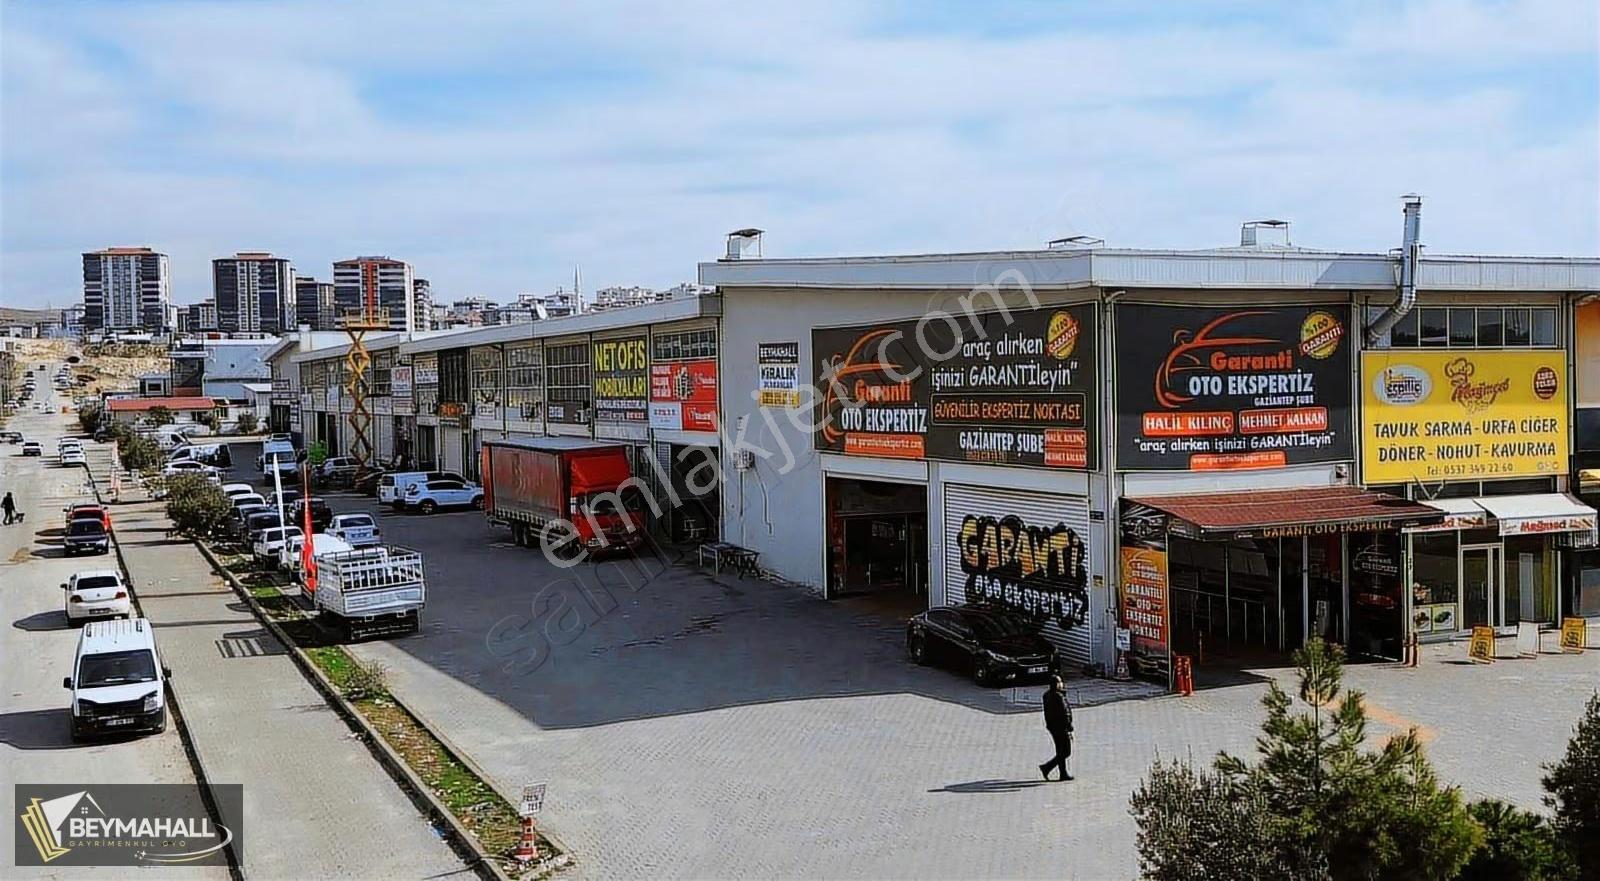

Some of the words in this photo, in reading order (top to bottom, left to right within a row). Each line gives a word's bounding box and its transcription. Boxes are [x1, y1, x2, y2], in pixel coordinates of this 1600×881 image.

[594, 342, 617, 371] NET
[618, 340, 646, 369] OFİS
[997, 334, 1042, 355] alırken
[1209, 350, 1292, 371] Garanti
[761, 366, 796, 380] KİRALIK
[932, 367, 964, 389] işinizi
[1189, 375, 1222, 396] OTO
[1228, 369, 1313, 395] EKSPERTİZ
[855, 378, 911, 402] Garanti
[841, 407, 863, 430] OTO
[865, 402, 928, 432] EKSPERTİZ
[934, 400, 980, 420] GÜVENİLİR
[982, 397, 1030, 420] EKSPERTİZ
[1033, 400, 1081, 421] NOKTASI
[1145, 411, 1183, 430] HALİL
[1187, 415, 1232, 434] KILINÇ
[1241, 414, 1283, 430] MEHMET
[1286, 411, 1325, 427] KALKAN
[1374, 421, 1418, 438] TAVUK
[1425, 419, 1472, 437] SARMA
[1482, 418, 1516, 434] URFA
[1520, 415, 1558, 433] CİĞER
[960, 427, 1013, 451] GAZİANTEP
[1017, 433, 1044, 457] ŞUBE
[1171, 436, 1209, 450] alırken
[1215, 437, 1246, 453] işinizi
[1379, 444, 1426, 462] DÖNER
[1437, 444, 1481, 460] NOHUT
[1491, 442, 1556, 457] KAVURMA
[1427, 466, 1442, 475] Tel:
[1443, 464, 1465, 475] 0537
[1488, 463, 1498, 472] 22
